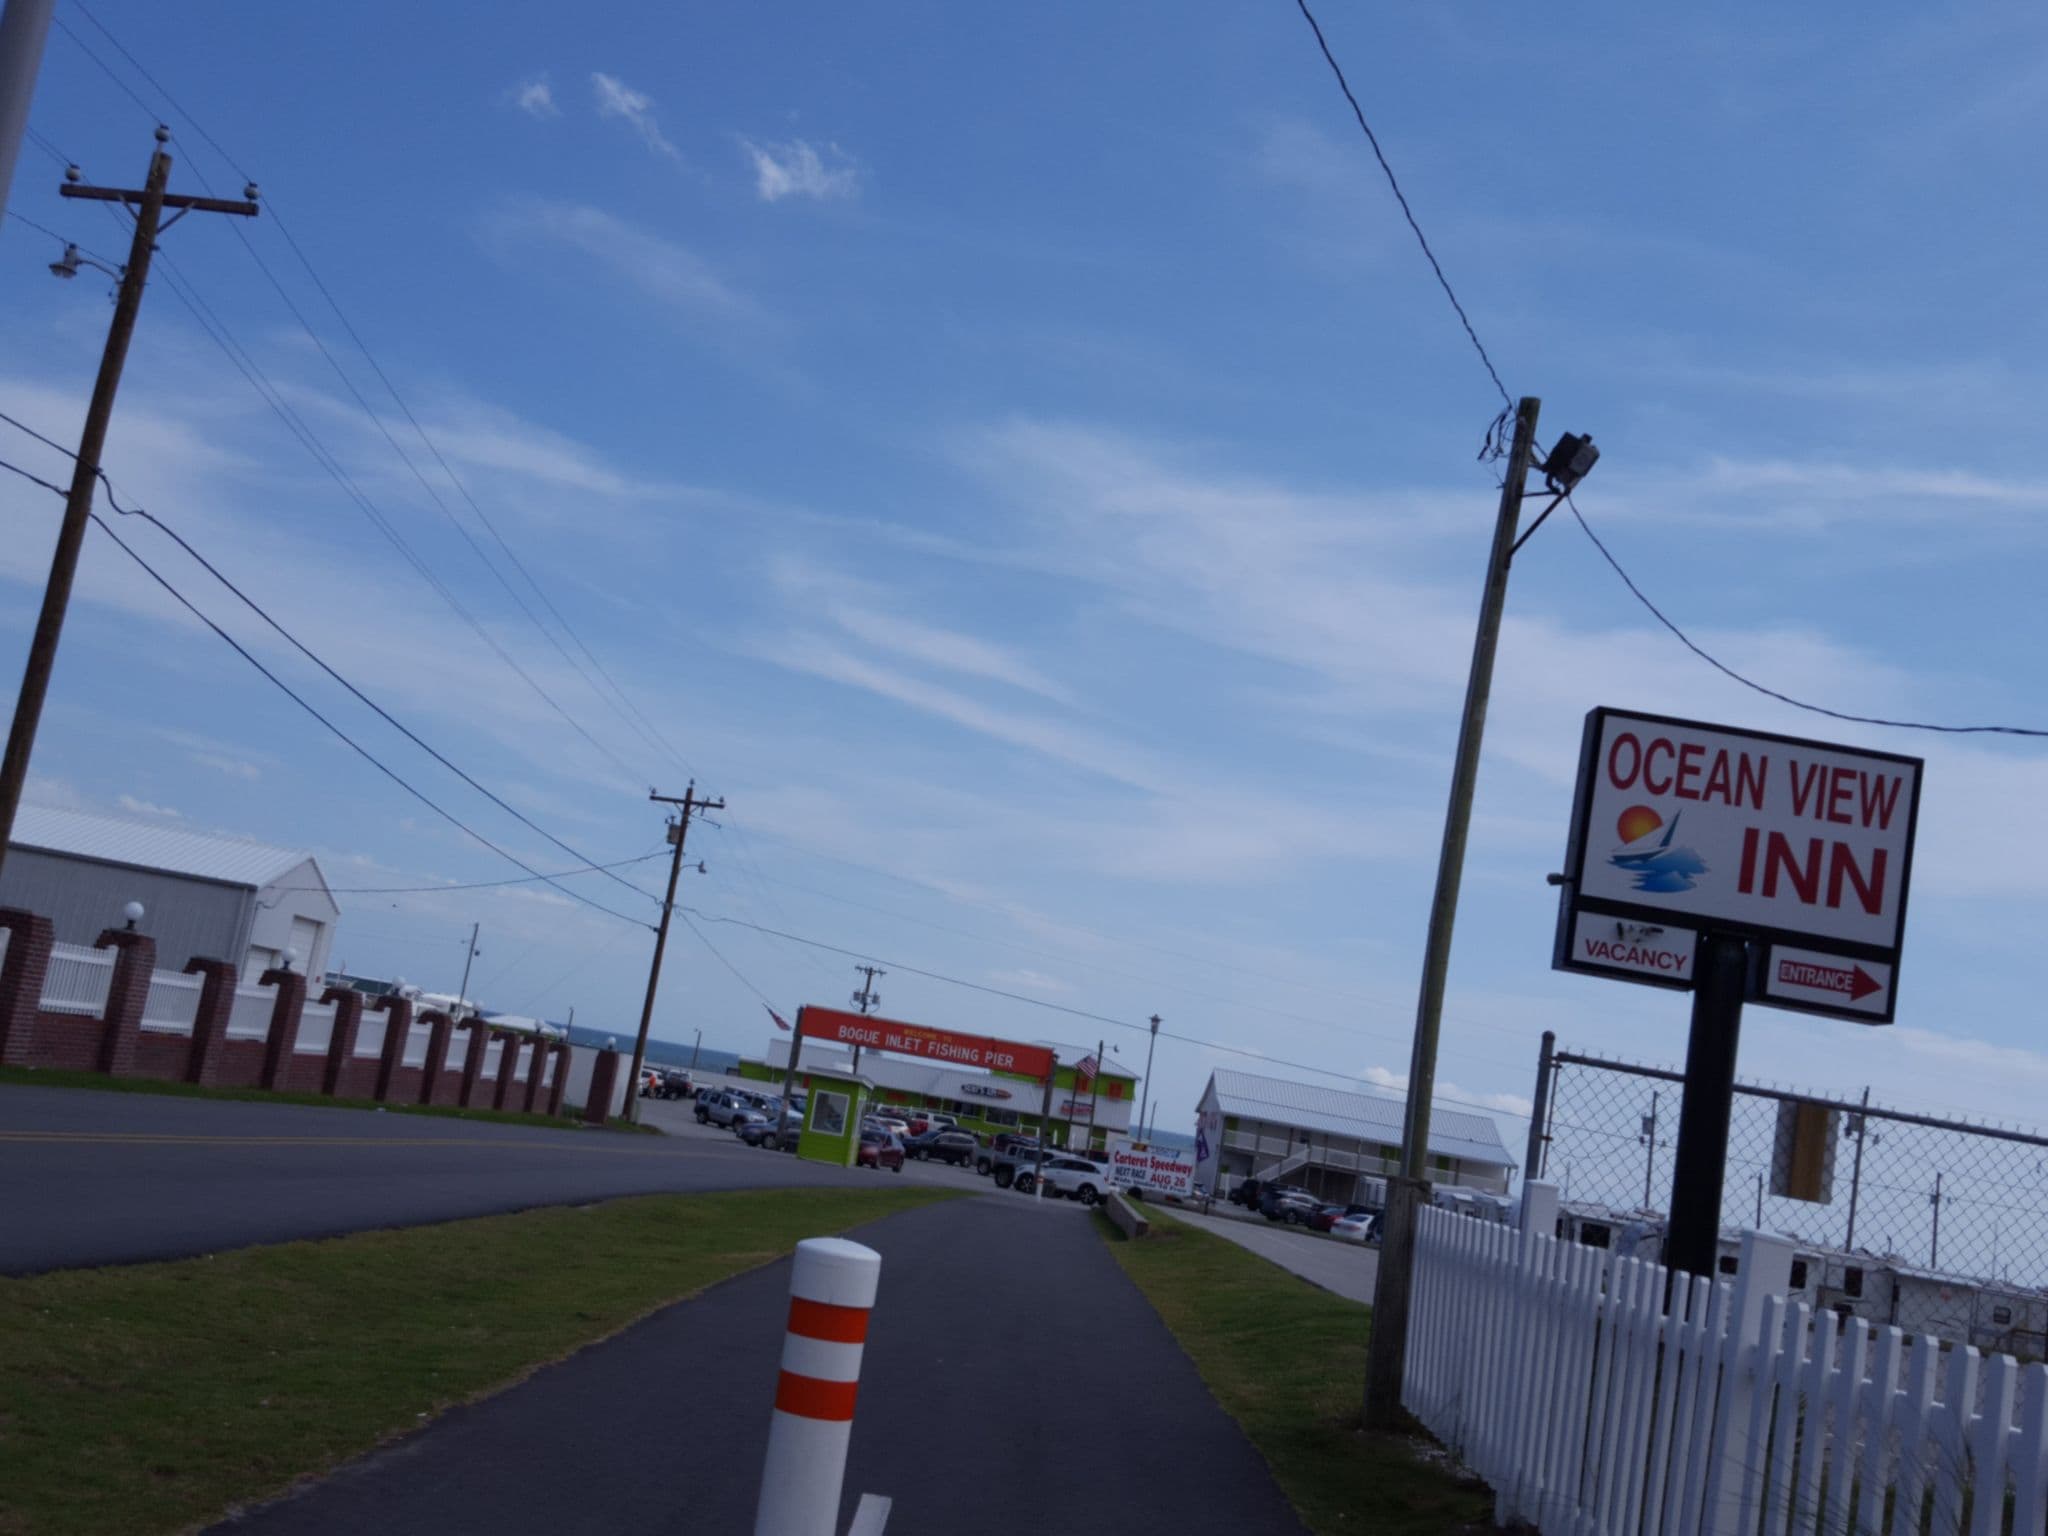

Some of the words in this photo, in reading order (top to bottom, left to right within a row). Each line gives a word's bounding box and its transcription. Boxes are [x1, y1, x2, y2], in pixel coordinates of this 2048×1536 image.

[1607, 732, 1768, 811] OCEAN
[1790, 759, 1902, 830] VIEW
[1737, 827, 1888, 915] INN
[1585, 938, 1687, 971] VACANCY
[1780, 963, 1854, 991] ENTRANCE
[838, 1025, 880, 1044] BOGUE
[885, 1033, 922, 1051] INLET
[928, 1041, 979, 1062] FISHING
[984, 1051, 1014, 1067] PIER
[1114, 1150, 1148, 1168] Carteret
[1150, 1156, 1193, 1177] Speedway
[1115, 1166, 1130, 1177] NEXT
[1150, 1174, 1171, 1185] AUG
